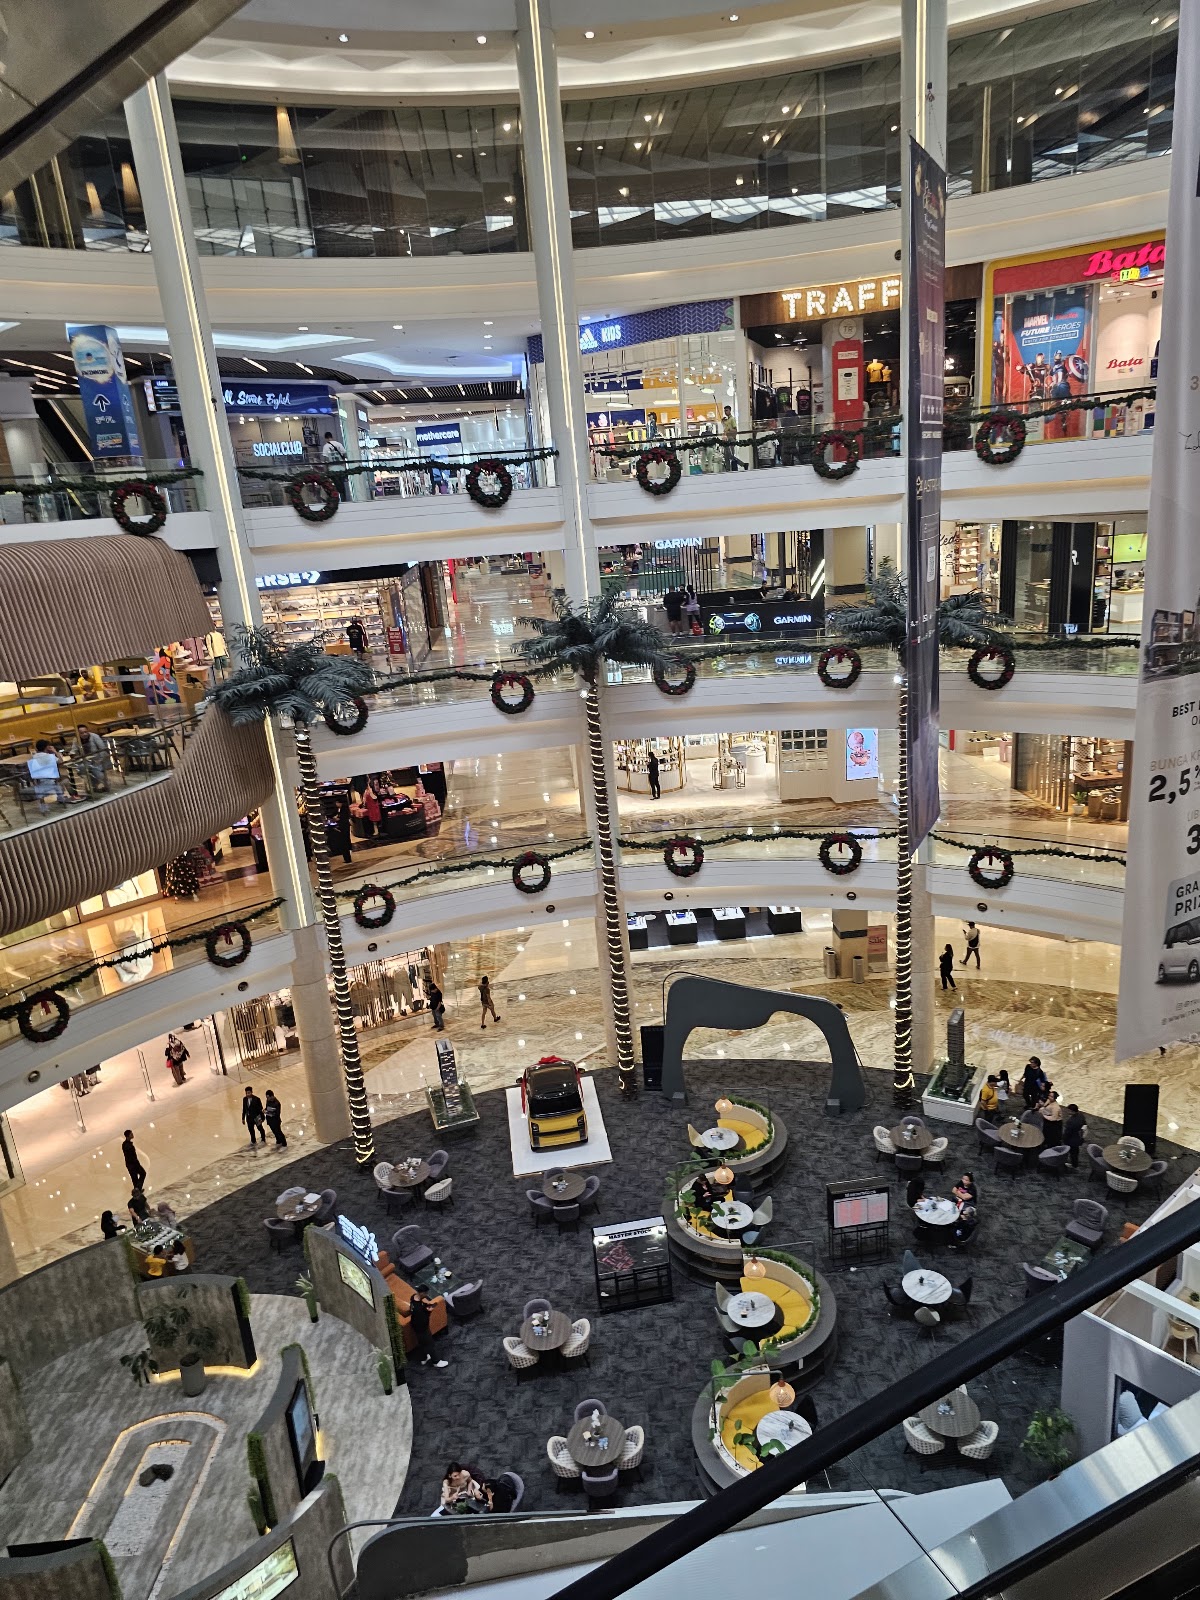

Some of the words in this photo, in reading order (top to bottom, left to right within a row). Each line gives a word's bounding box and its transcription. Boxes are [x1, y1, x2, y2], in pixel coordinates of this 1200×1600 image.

[1083, 243, 1165, 276] Bata
[782, 279, 901, 319] TRAFF
[1020, 327, 1050, 337] FUTURE
[1050, 321, 1081, 332] HEROES
[1023, 314, 1049, 328] MARVEL
[601, 324, 622, 342] KIDS
[1106, 357, 1143, 369] Bata
[237, 390, 263, 405] Street
[265, 392, 291, 410] English
[416, 429, 460, 442] mothercare
[655, 537, 703, 550] GARMIN
[773, 614, 811, 625] GARMIN
[1172, 701, 1196, 717] BEST
[1150, 754, 1188, 772] BUNGA
[608, 1231, 632, 1240] MASTER
